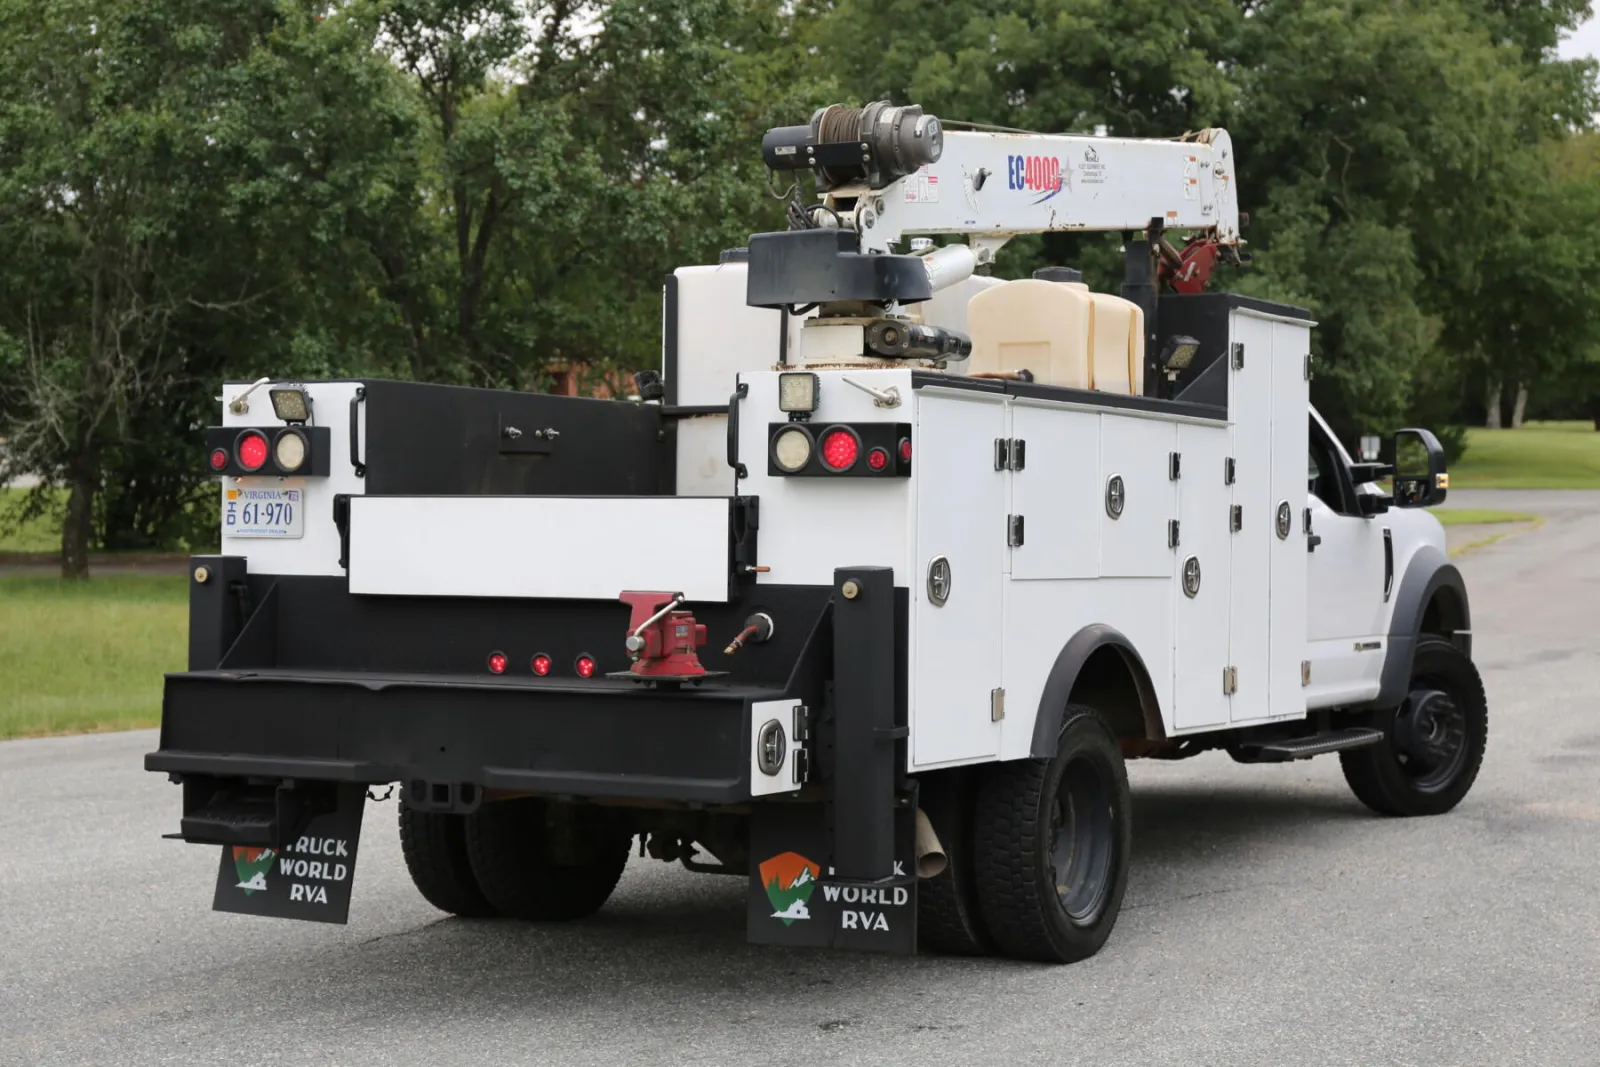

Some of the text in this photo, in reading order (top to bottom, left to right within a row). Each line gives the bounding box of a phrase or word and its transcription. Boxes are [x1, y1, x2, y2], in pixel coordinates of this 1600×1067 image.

[244, 490, 282, 500] VIRGINIA
[286, 836, 348, 857] RUCK
[279, 858, 347, 881] WORLD
[290, 884, 328, 904] RVA
[823, 885, 908, 905] WORLD
[842, 910, 890, 932] RVA
